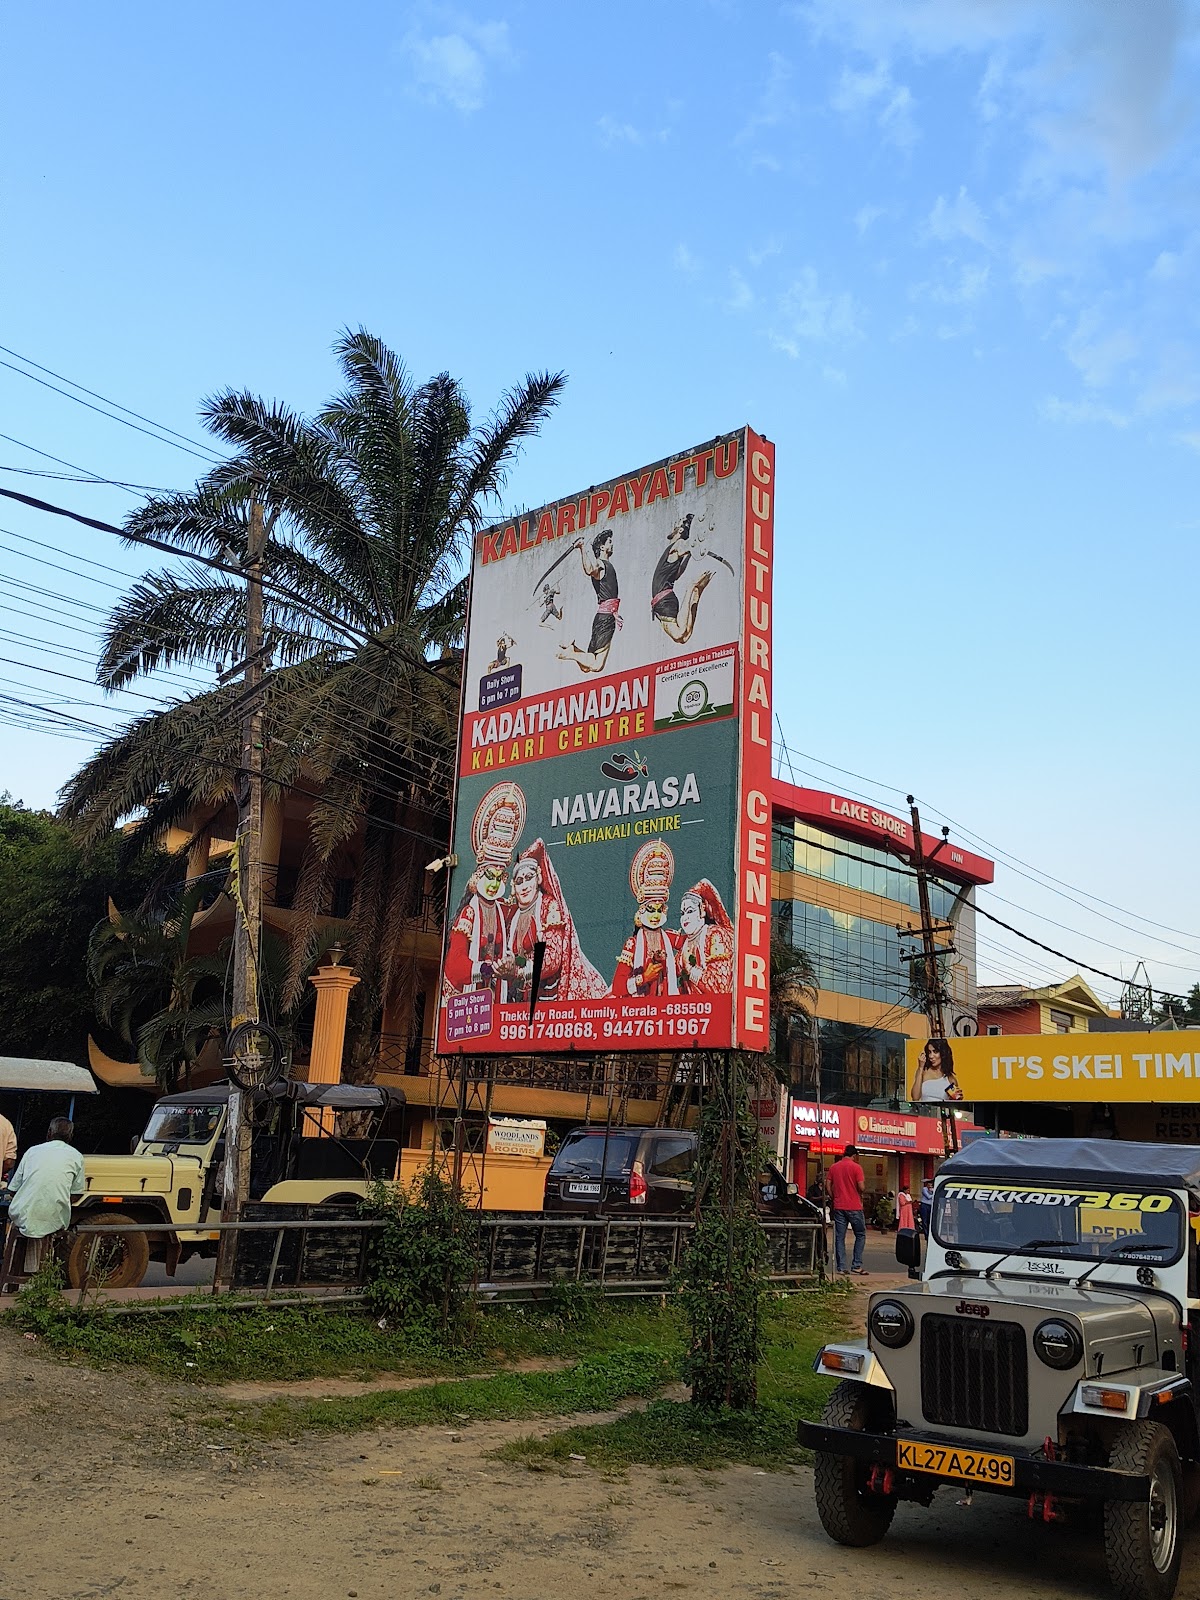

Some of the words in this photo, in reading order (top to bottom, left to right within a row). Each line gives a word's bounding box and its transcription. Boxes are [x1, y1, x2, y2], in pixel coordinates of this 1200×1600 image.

[481, 439, 739, 567] KALARIPAYATTU
[748, 450, 770, 748] CULTURAL
[677, 659, 692, 668] things
[712, 647, 735, 659] Thekkady
[486, 678, 500, 690] Daily
[500, 674, 515, 686] Show
[661, 671, 690, 683] Certificate
[698, 661, 729, 674] Excellence
[481, 695, 486, 706] 6
[487, 693, 496, 704] pm
[496, 691, 503, 700] to
[504, 689, 509, 698] 7
[509, 687, 519, 697] pm
[471, 675, 649, 749] KADATHANADAN
[471, 735, 545, 770] KALARI
[558, 711, 646, 751] CENTRE
[551, 772, 701, 827] NAVARASA
[566, 822, 631, 846] KATHAKALI
[634, 814, 681, 836] CENTRE
[830, 798, 869, 823] LAKE
[871, 811, 907, 838] SHORE
[951, 851, 964, 864] INN
[745, 790, 768, 1033] CENTRE
[453, 996, 469, 1007] Daily
[469, 994, 485, 1005] Show
[548, 1008, 577, 1020] Road,
[581, 1006, 618, 1020] Kumily,
[621, 1004, 657, 1017] Kerala
[660, 1002, 712, 1015] -685509
[448, 1010, 453, 1018] 5
[454, 1008, 465, 1019] pm
[465, 1006, 473, 1015] to
[474, 1005, 479, 1014] 6
[480, 1004, 490, 1015] pm
[466, 1015, 472, 1024] &
[448, 1027, 453, 1036] 7
[454, 1026, 465, 1037] pm
[465, 1023, 473, 1033] to
[473, 1023, 478, 1032] 8
[479, 1021, 490, 1032] pm
[500, 1021, 597, 1040] 9961740868,
[603, 1018, 710, 1038] 9447611967
[991, 1055, 1044, 1080] IT'S
[1052, 1054, 1123, 1079] SKEI
[1160, 1106, 1200, 1119] PERI
[494, 1130, 539, 1140] WOODLANDS
[795, 1123, 816, 1137] Saree
[494, 1145, 536, 1155] ROOMS
[943, 1186, 1082, 1207] THEKKADY
[1079, 1191, 1173, 1213] 360
[955, 1300, 990, 1318] Jeep
[899, 1444, 1012, 1482] KL27A2499
